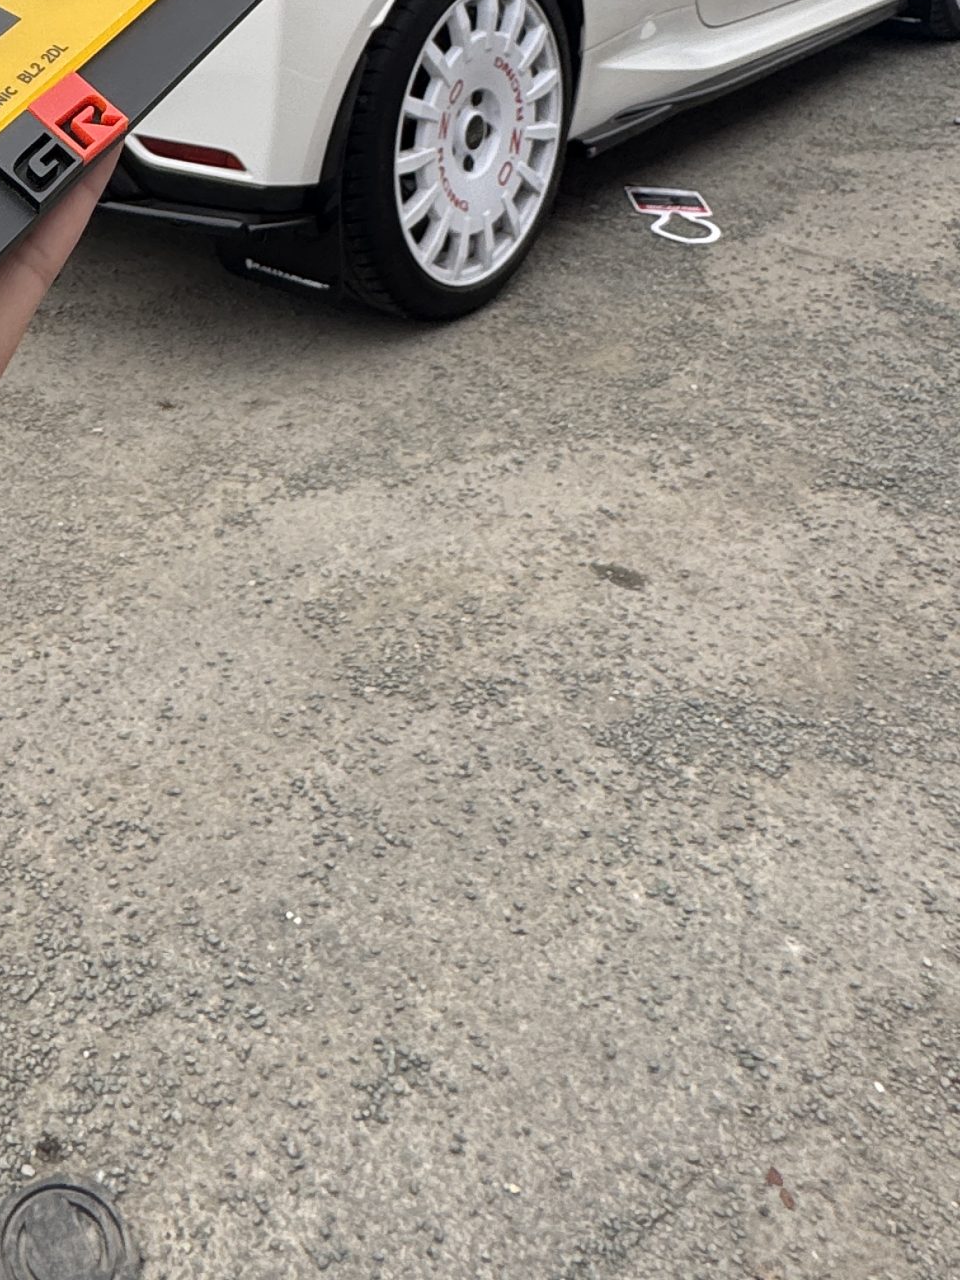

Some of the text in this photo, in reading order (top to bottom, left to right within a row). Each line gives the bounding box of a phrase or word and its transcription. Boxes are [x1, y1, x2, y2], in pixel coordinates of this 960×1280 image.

[16, 62, 46, 85] BL2
[41, 43, 70, 65] 2DL
[12, 94, 126, 194] GR
